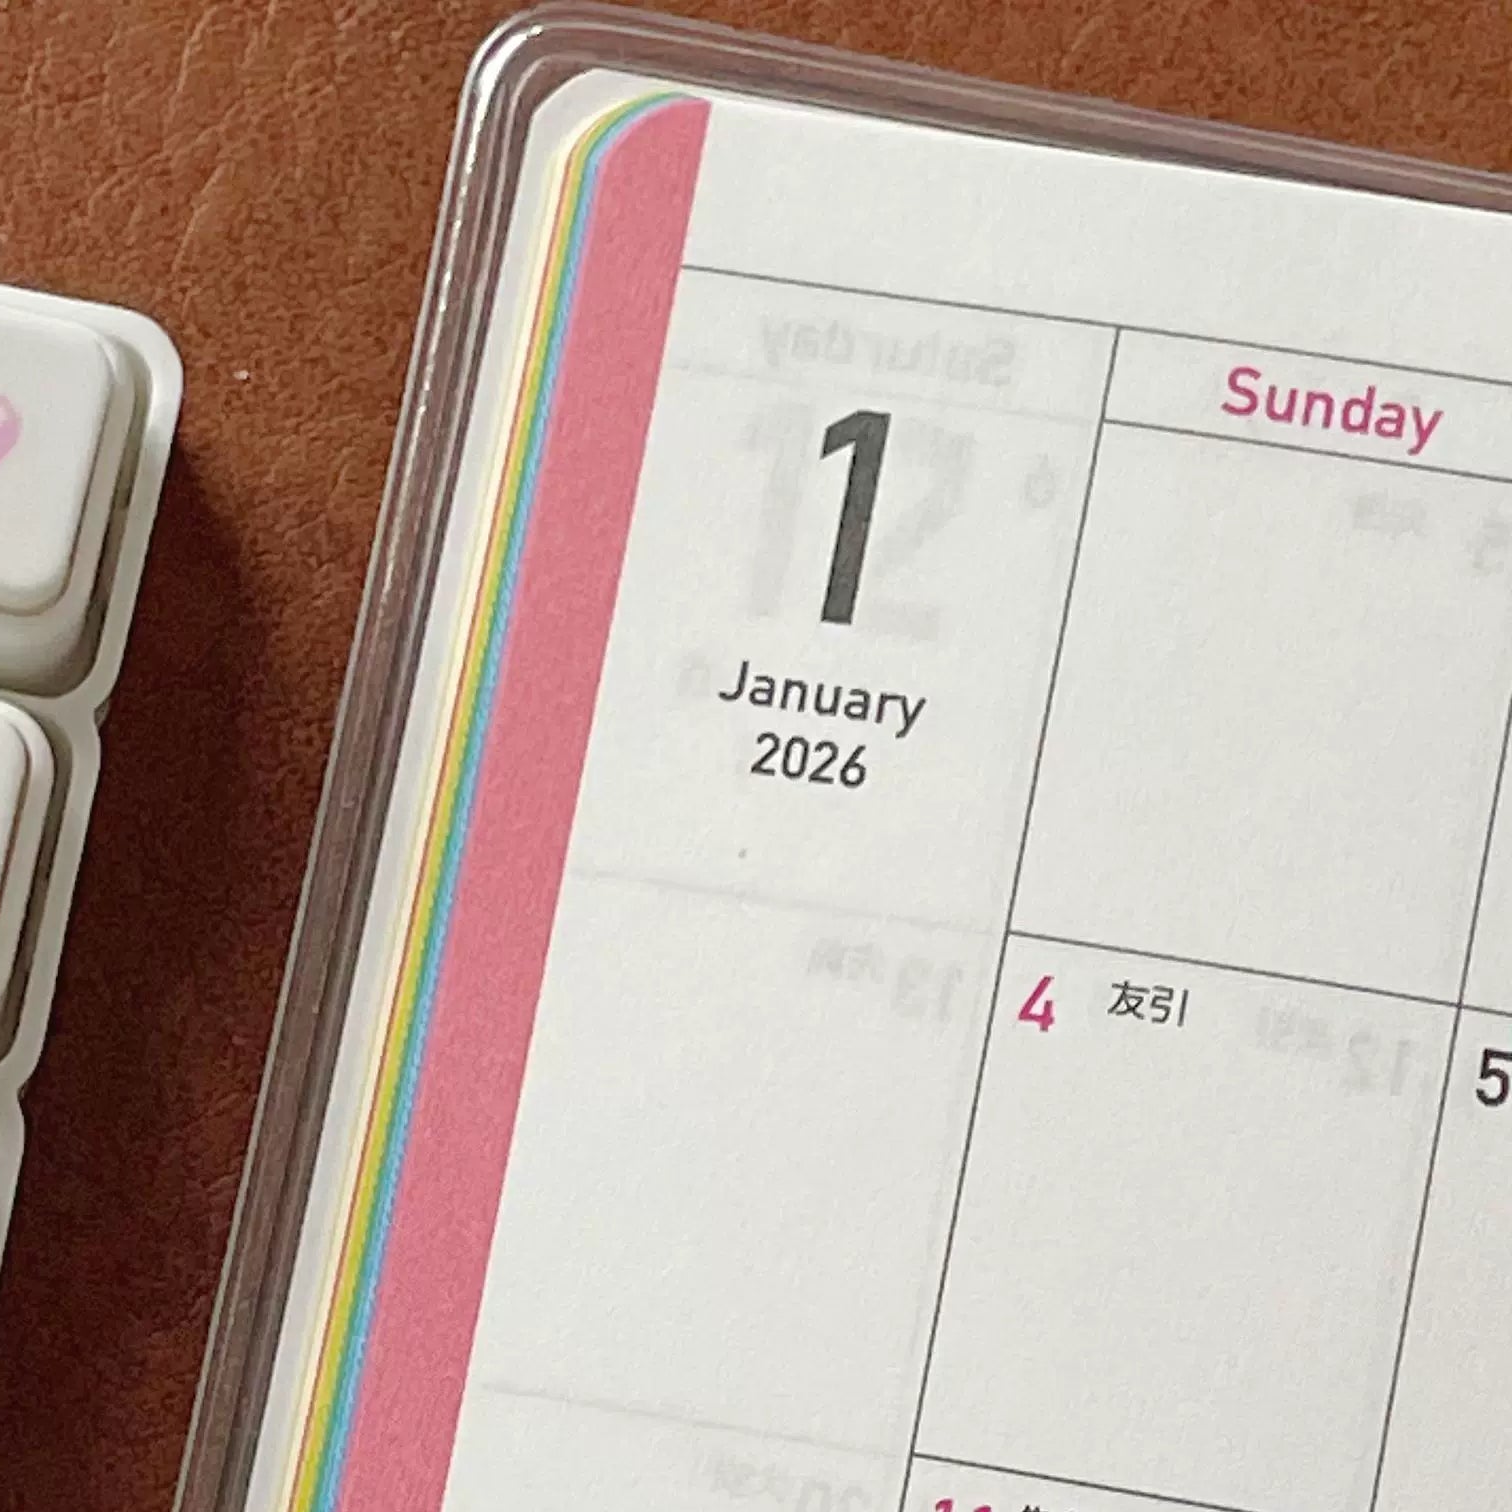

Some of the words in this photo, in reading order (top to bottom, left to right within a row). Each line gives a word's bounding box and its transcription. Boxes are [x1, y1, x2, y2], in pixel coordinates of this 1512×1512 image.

[1220, 366, 1445, 455] Sunday
[820, 410, 891, 625] 1
[718, 661, 926, 737] January
[751, 732, 866, 788] 2026
[1018, 976, 1054, 1032] 4
[1108, 981, 1189, 1027] 友引
[1476, 1048, 1511, 1107] 5
